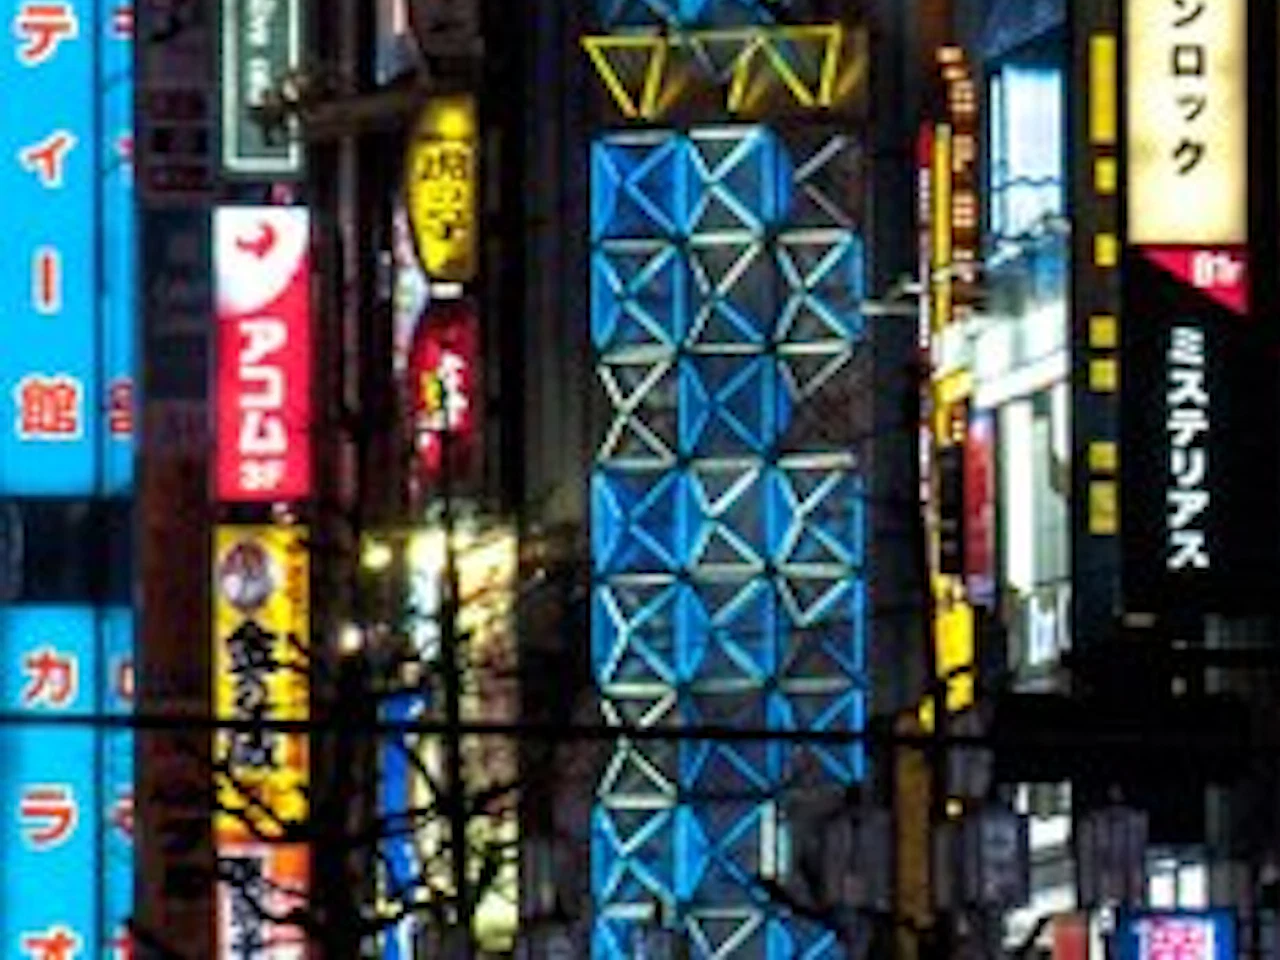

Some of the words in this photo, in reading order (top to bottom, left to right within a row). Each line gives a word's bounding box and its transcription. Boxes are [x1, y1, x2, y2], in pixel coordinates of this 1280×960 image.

[238, 318, 288, 454] アコム
[1166, 326, 1210, 570] ミステリアス
